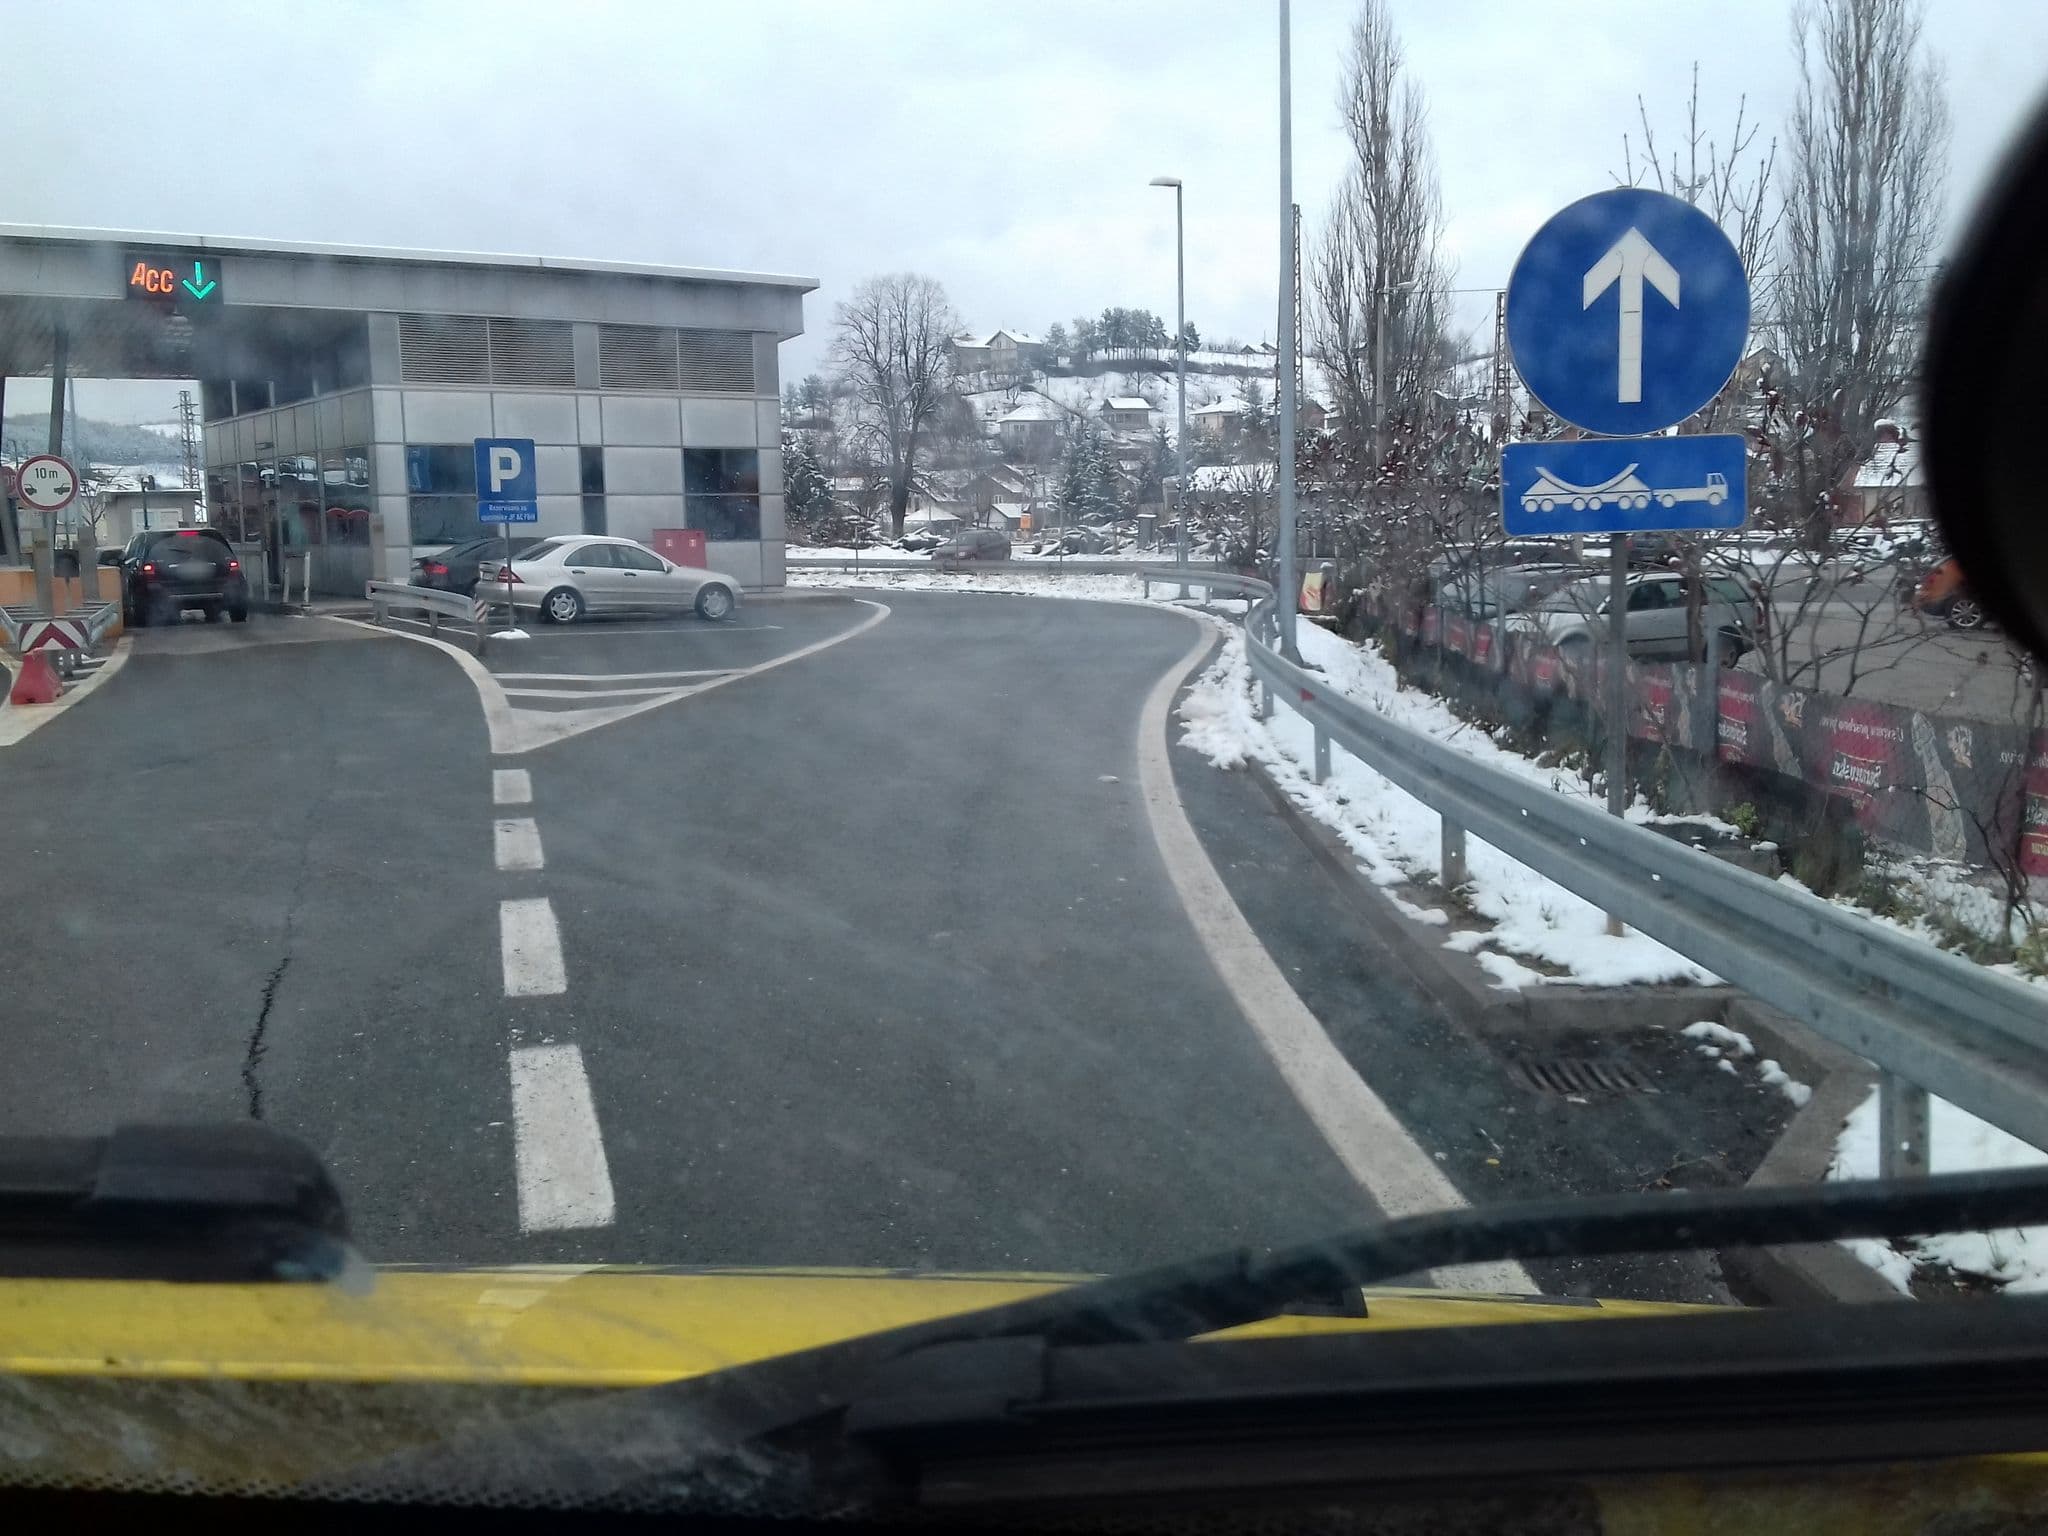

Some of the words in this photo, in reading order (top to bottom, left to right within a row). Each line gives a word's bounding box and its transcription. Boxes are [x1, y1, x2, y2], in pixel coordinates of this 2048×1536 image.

[35, 468, 47, 479] 10
[49, 470, 58, 479] m
[489, 447, 521, 491] P
